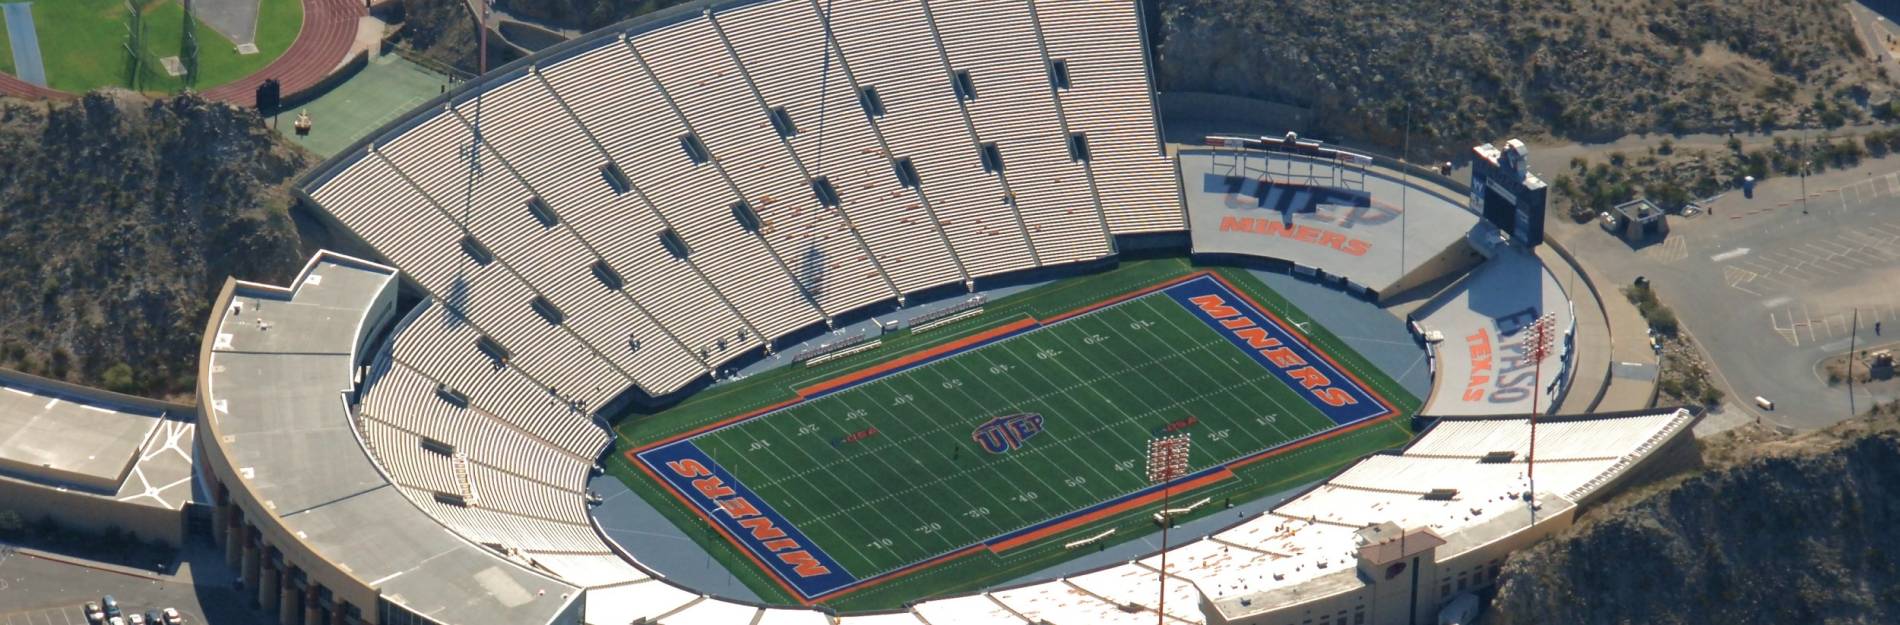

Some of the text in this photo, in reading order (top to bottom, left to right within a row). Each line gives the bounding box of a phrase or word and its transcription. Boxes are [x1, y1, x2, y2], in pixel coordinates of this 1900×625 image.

[1219, 216, 1372, 257] MINERS
[1190, 293, 1359, 408] MINERS
[1462, 328, 1492, 402] TEXAS
[1256, 414, 1276, 426] 10
[972, 412, 1044, 454] UTEP
[1208, 430, 1229, 442] 20
[1064, 475, 1086, 488] 50
[1017, 491, 1038, 503] 40
[665, 458, 831, 578] MINERS
[969, 506, 990, 519] 30
[921, 522, 942, 535] 20
[874, 538, 893, 549] 10
